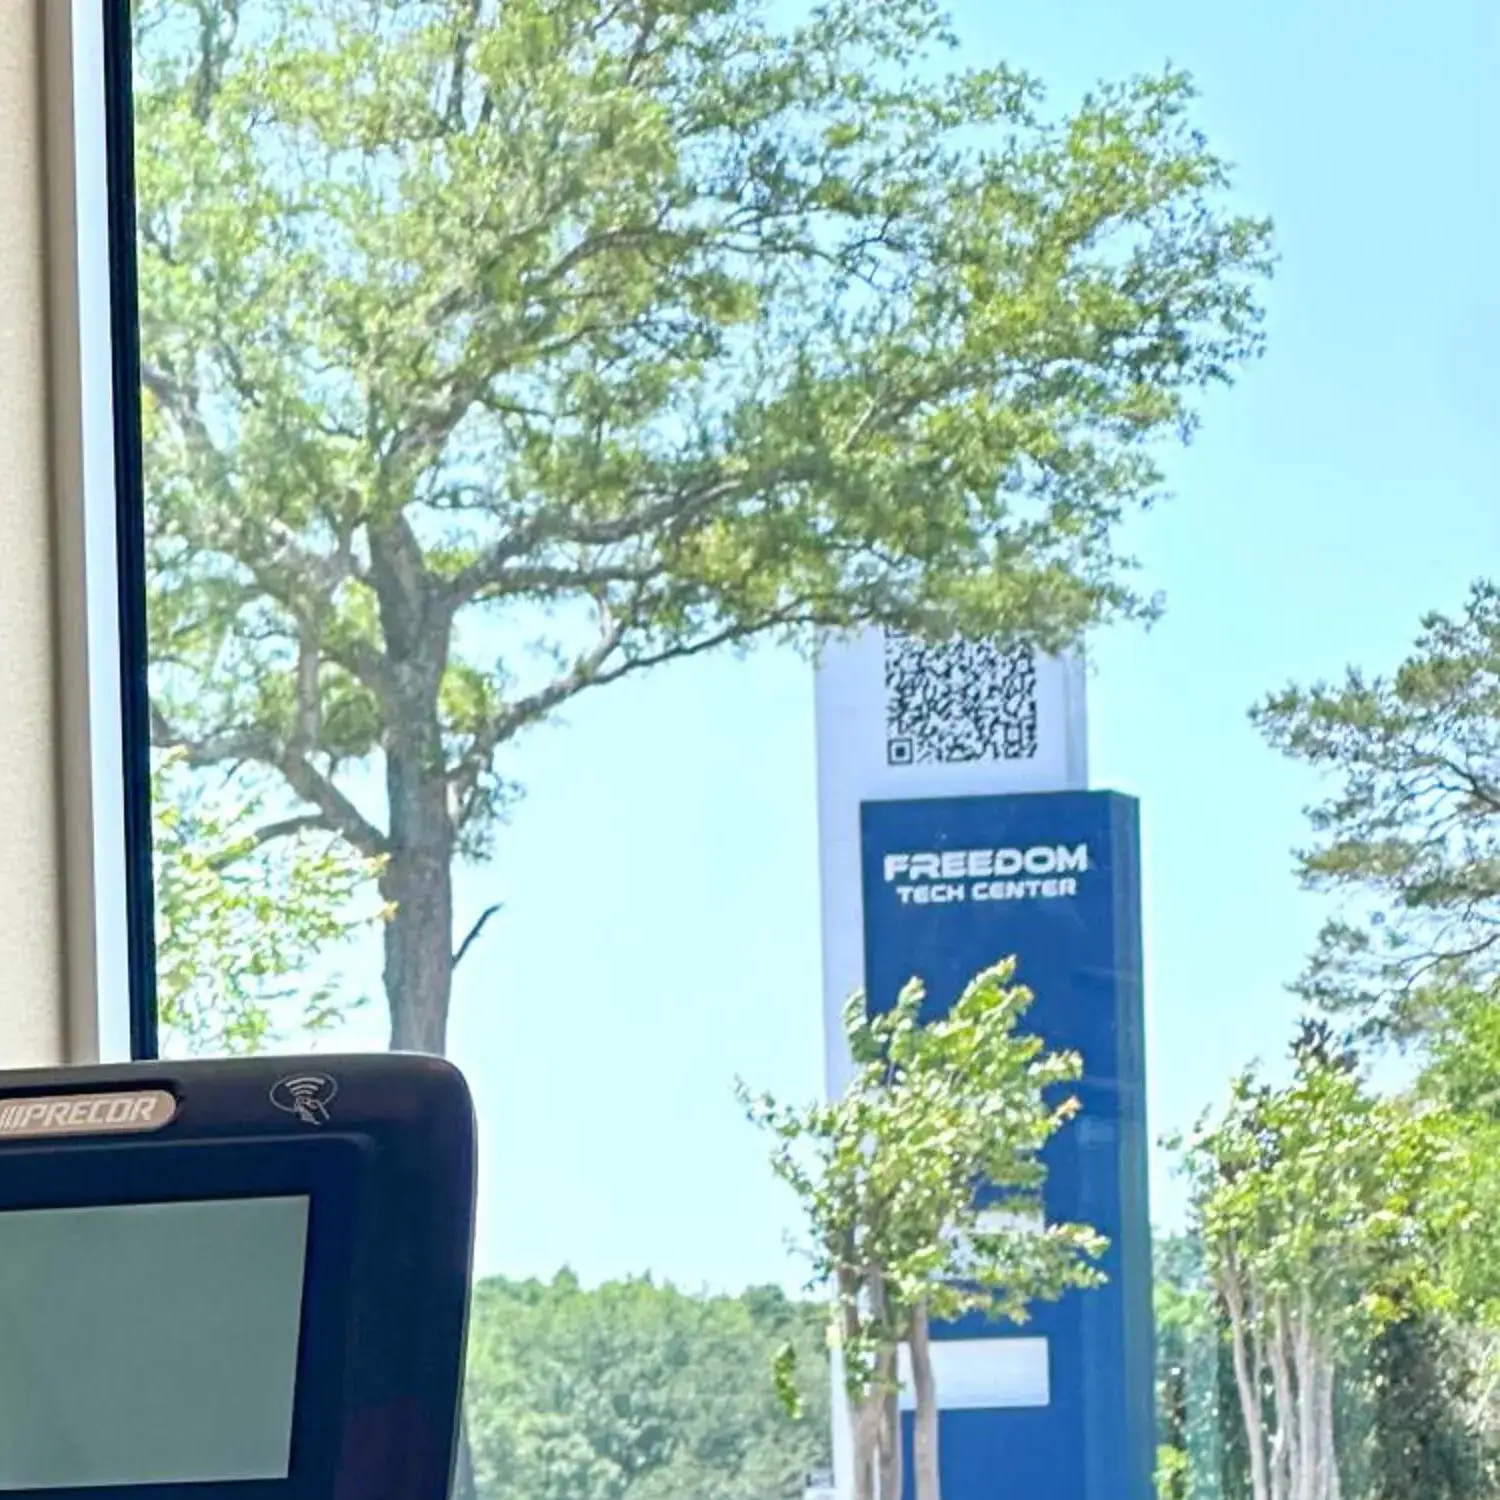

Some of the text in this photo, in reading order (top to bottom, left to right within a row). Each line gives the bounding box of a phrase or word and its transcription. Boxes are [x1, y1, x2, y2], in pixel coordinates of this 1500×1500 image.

[884, 843, 1088, 882] FREEDOM
[896, 878, 1077, 904] TECH CENTER
[17, 1096, 158, 1128] PRECOR
